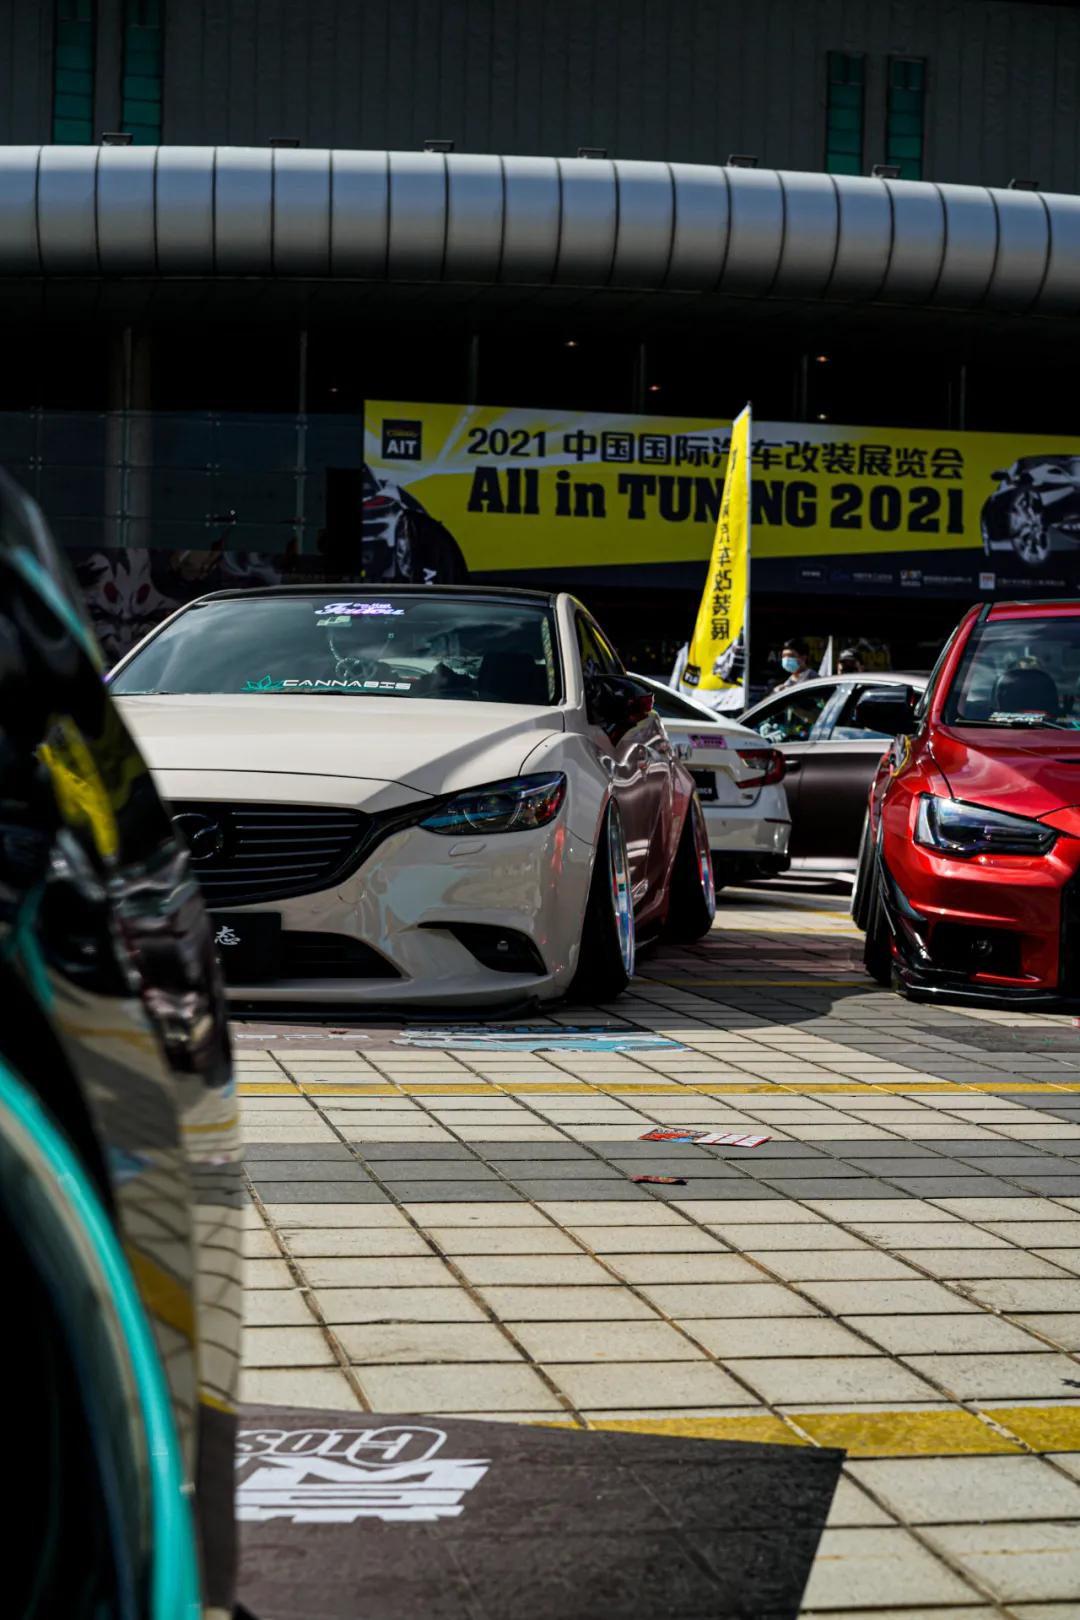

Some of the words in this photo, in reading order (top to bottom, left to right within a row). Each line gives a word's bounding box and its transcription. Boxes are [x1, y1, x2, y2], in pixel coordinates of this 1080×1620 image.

[386, 439, 418, 456] AIT
[467, 428, 546, 458] 2021
[467, 466, 540, 515] All
[555, 469, 606, 518] in
[618, 473, 818, 528] TUNNG
[829, 483, 965, 534] 2021
[282, 678, 412, 691] CANNABIS
